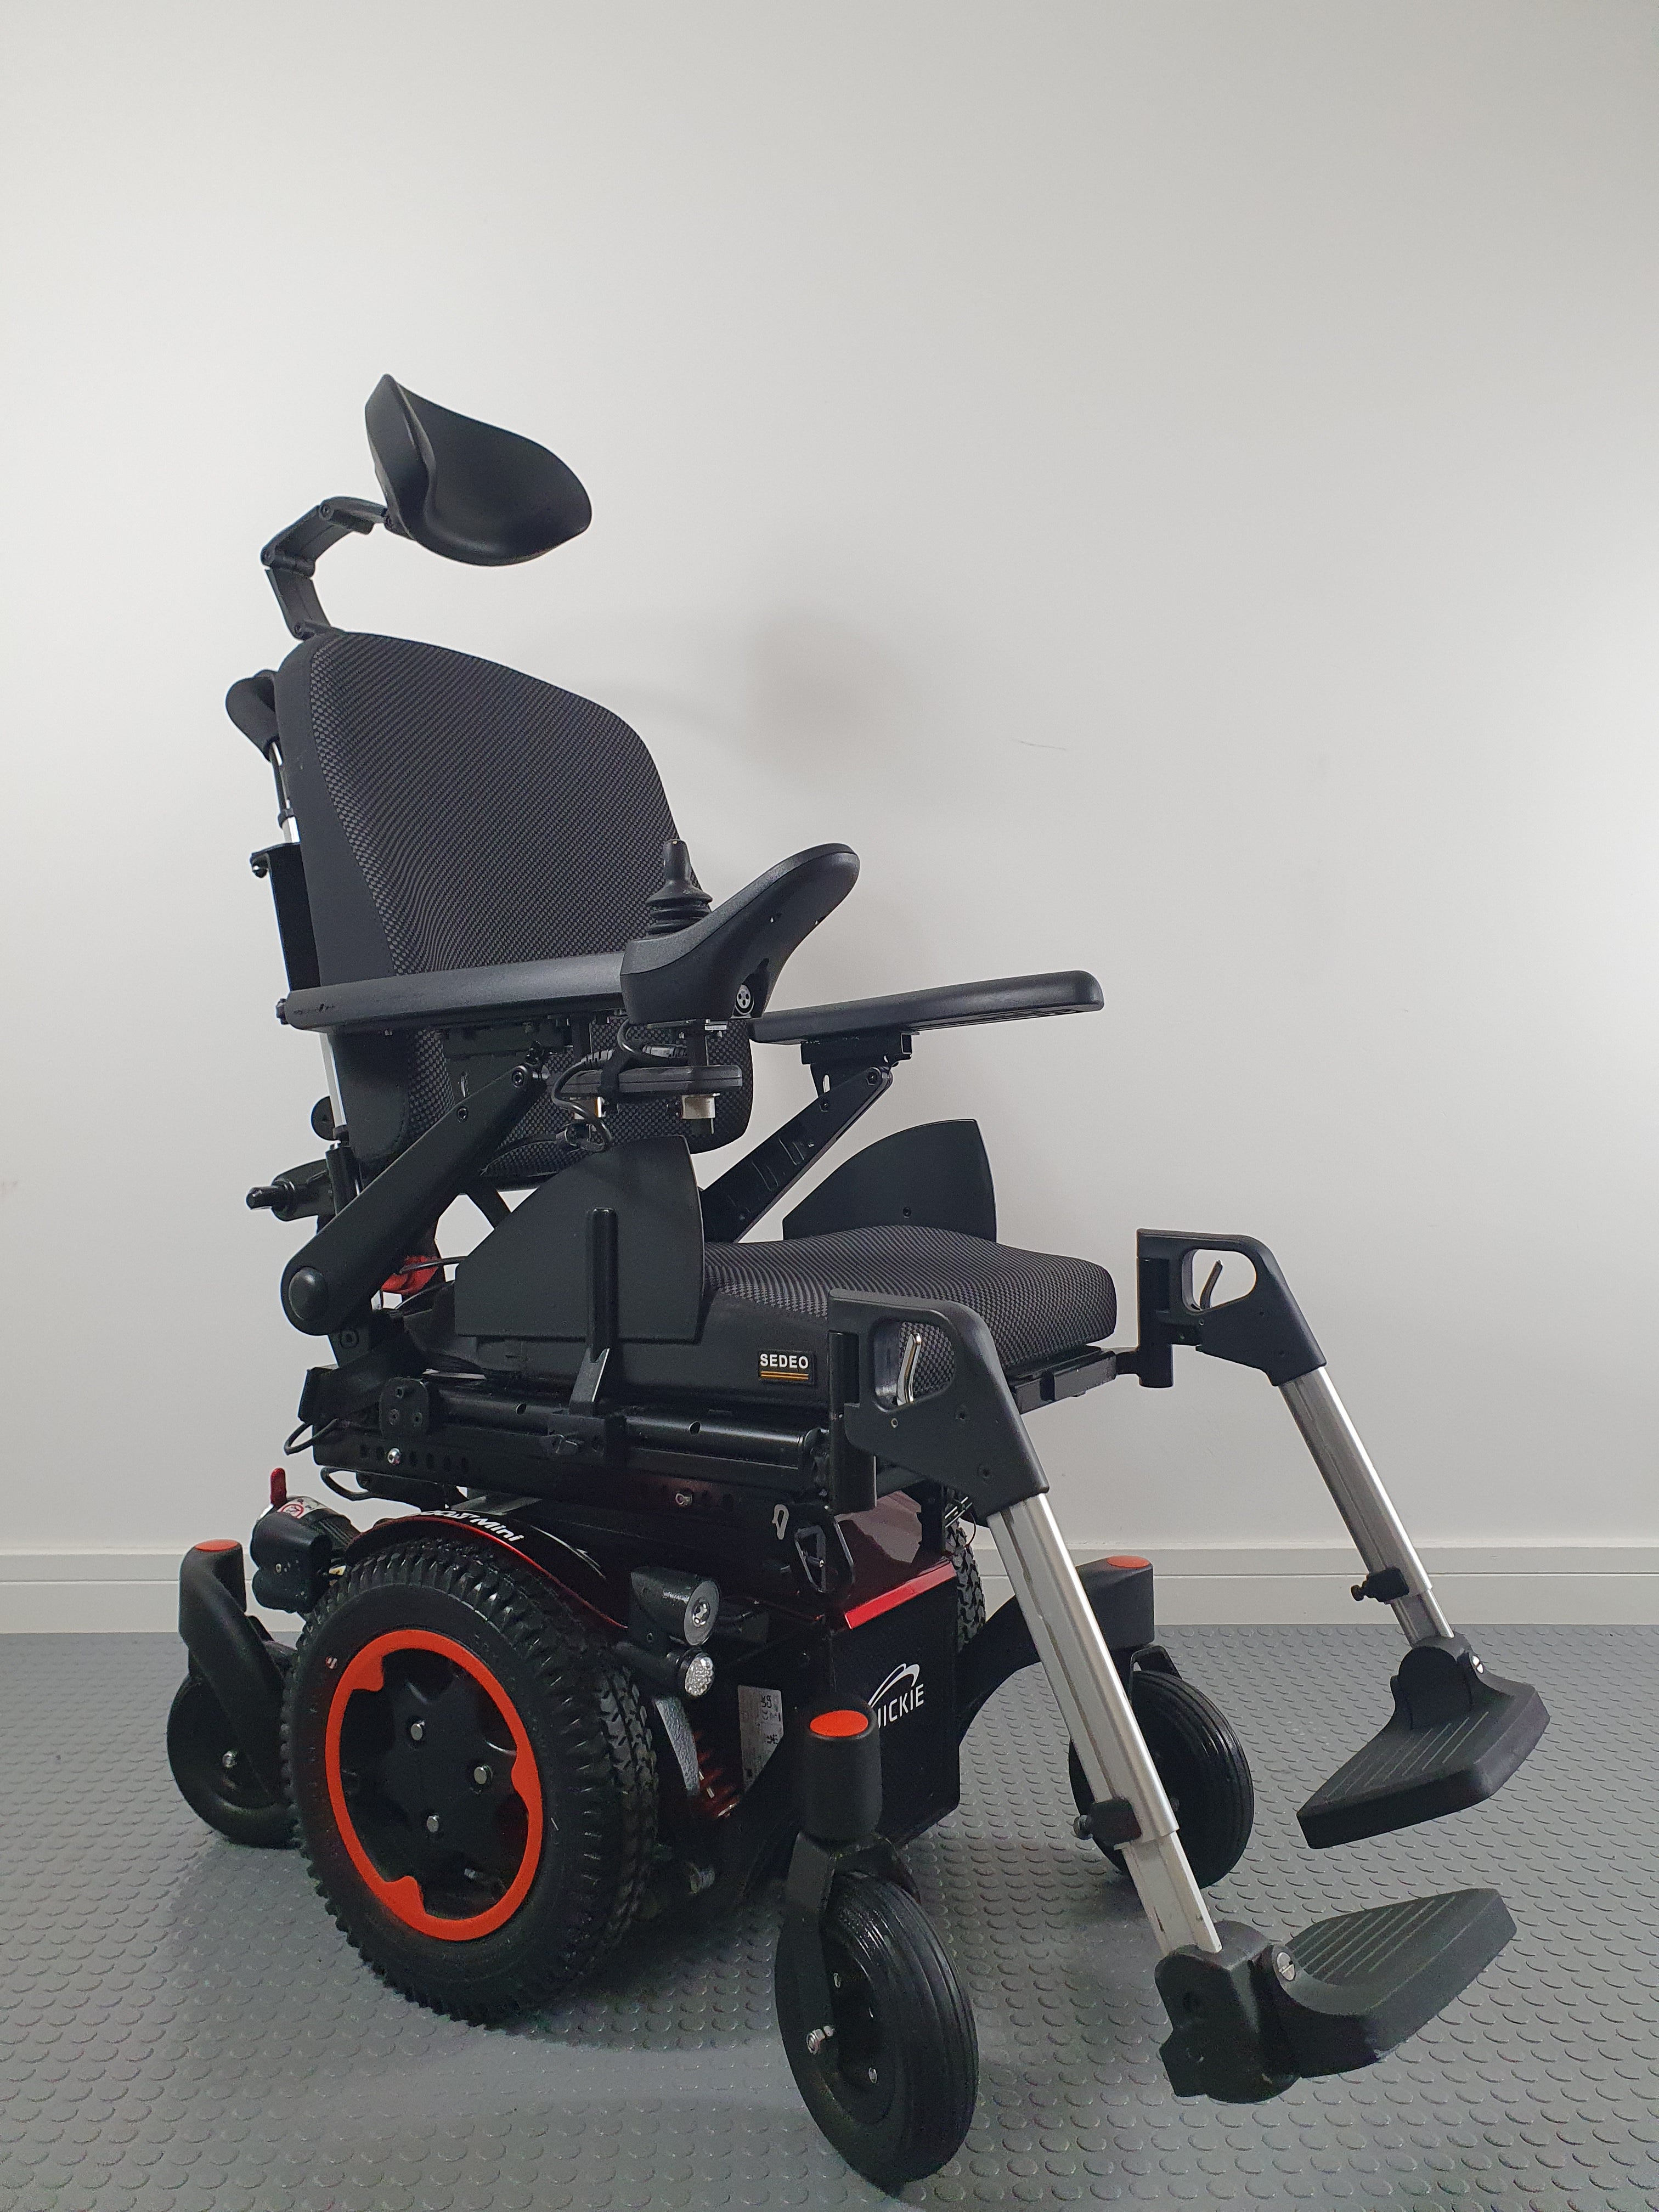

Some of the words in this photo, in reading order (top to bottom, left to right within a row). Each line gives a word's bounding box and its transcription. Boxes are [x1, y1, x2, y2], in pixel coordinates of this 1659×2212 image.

[760, 1353, 809, 1369] SEDEO
[470, 1517, 524, 1542] Mini
[878, 1683, 924, 1729] ICKIE
